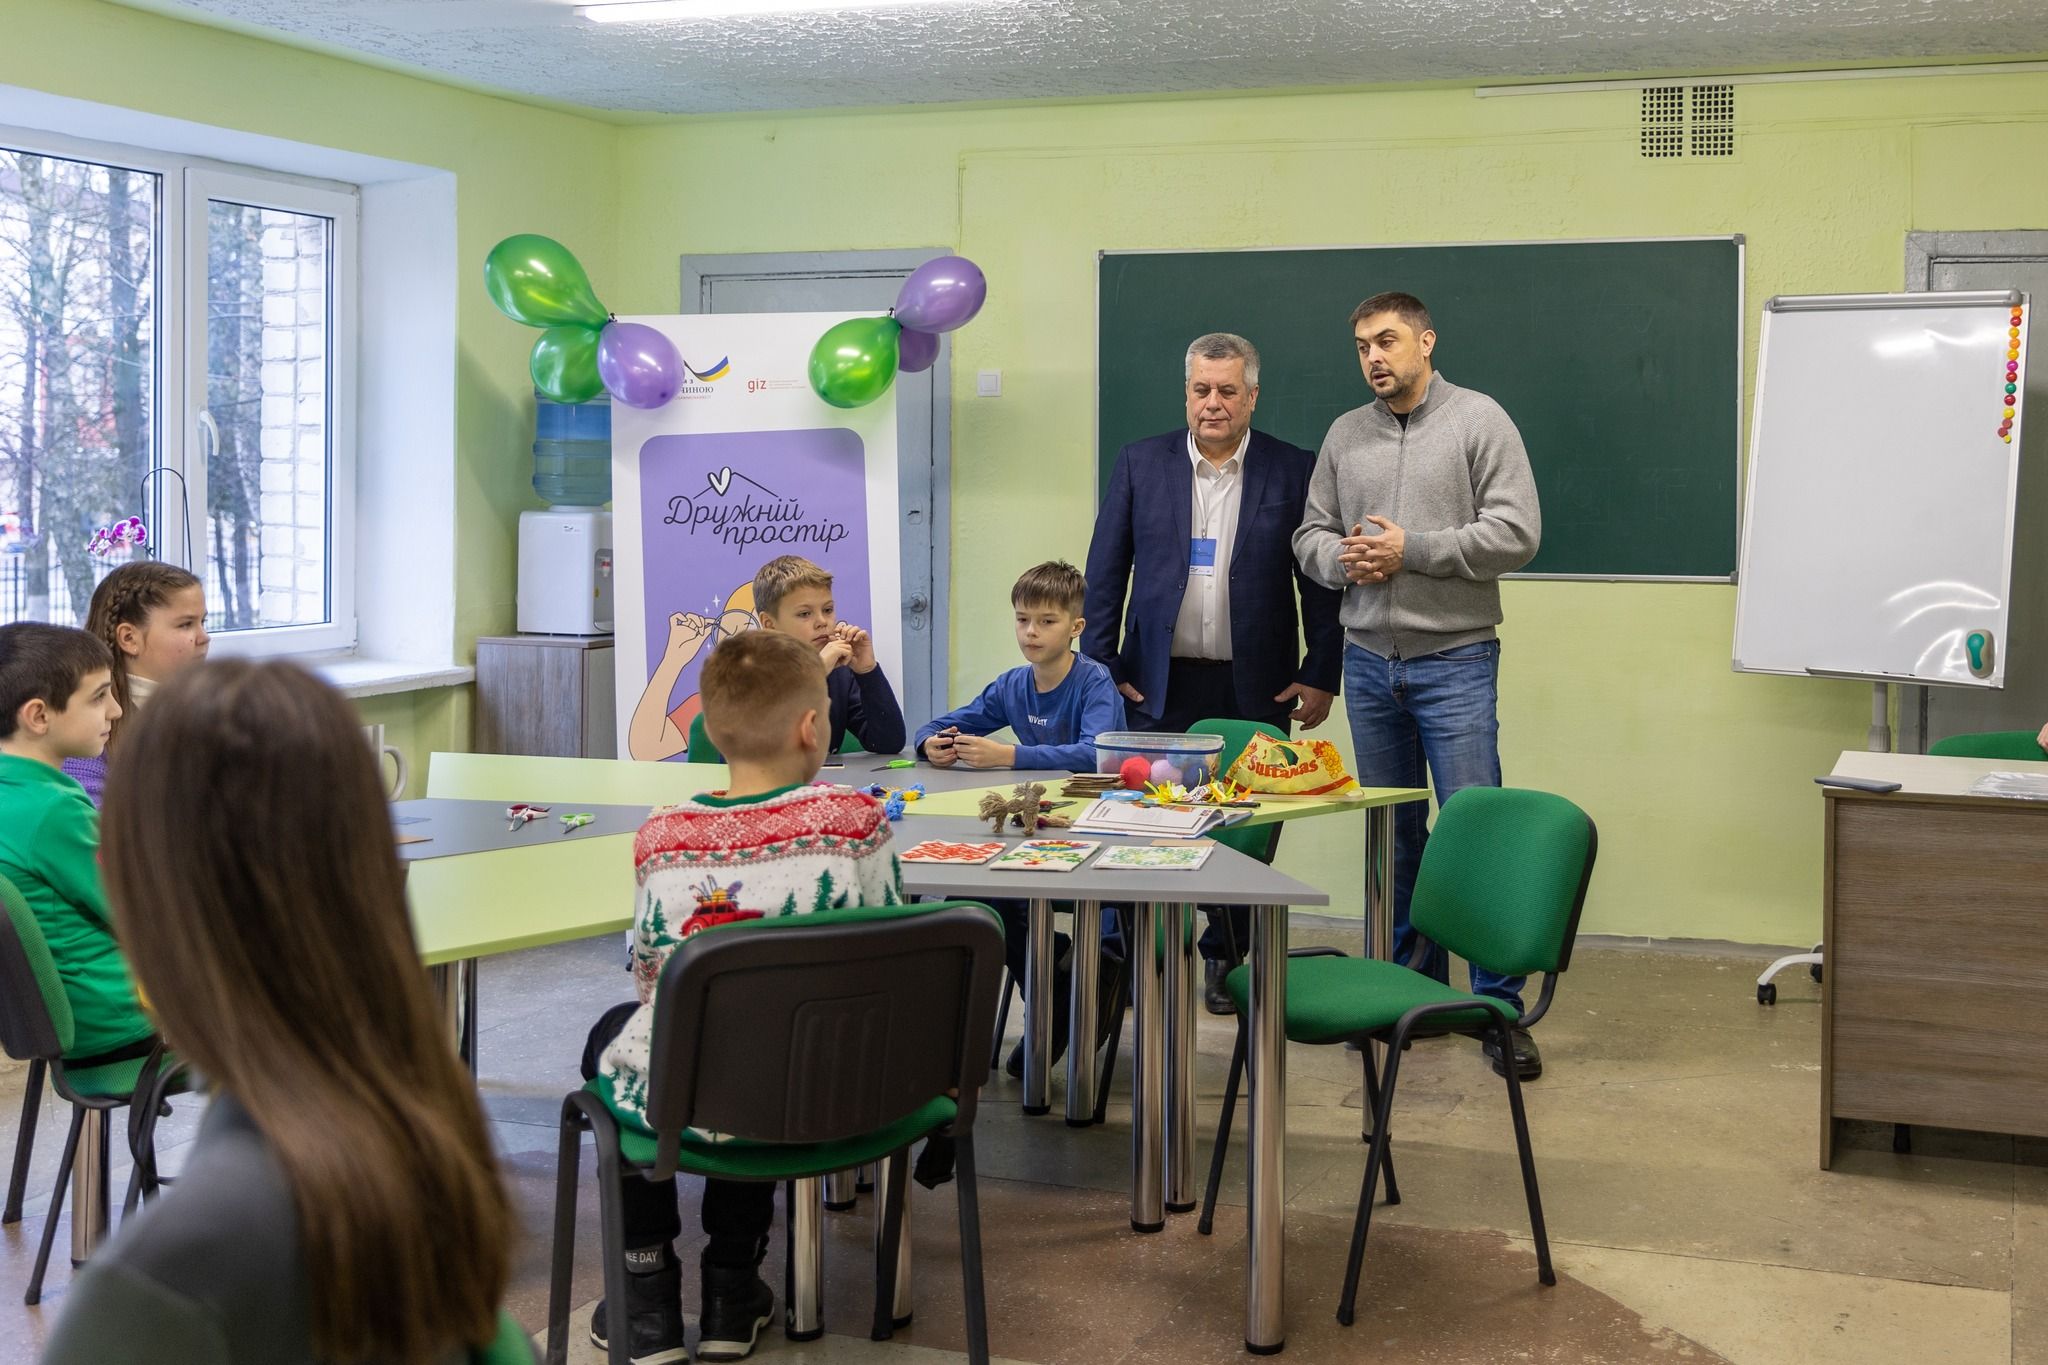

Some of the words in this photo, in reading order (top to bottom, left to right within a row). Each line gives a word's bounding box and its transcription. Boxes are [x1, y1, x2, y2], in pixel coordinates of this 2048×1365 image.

[747, 378, 767, 393] giz
[663, 494, 804, 535] Дружній
[723, 518, 850, 555] простір
[639, 1250, 658, 1263] DAY
